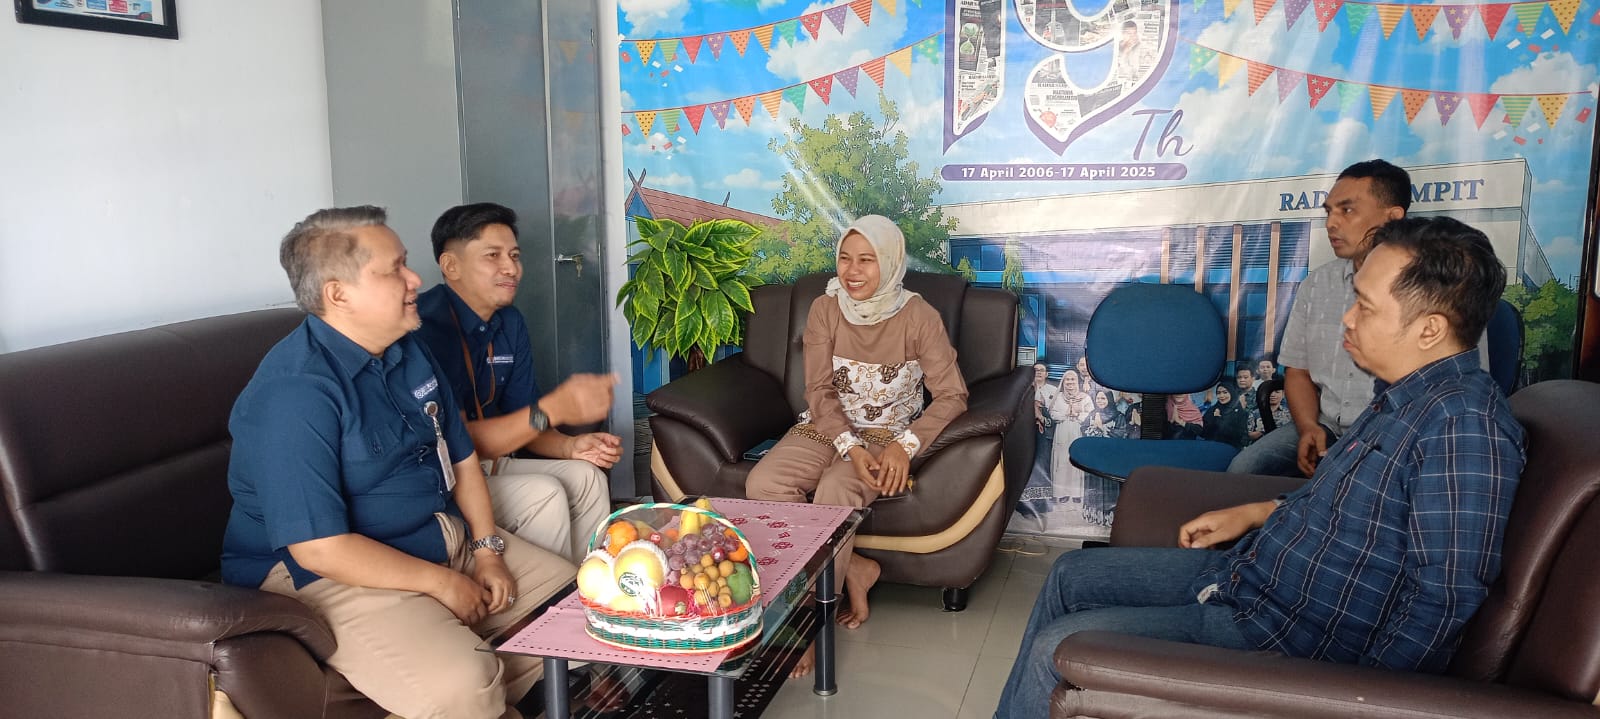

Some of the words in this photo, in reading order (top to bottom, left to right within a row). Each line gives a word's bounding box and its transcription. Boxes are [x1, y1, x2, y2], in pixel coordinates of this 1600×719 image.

[943, 0, 1180, 156] 19
[1132, 109, 1194, 160] Th
[961, 167, 976, 178] 17
[980, 167, 1014, 180] April
[1080, 166, 1115, 180] April
[1120, 166, 1156, 178] 2025
[1279, 190, 1329, 211] RAD
[1410, 178, 1485, 203] MPIT
